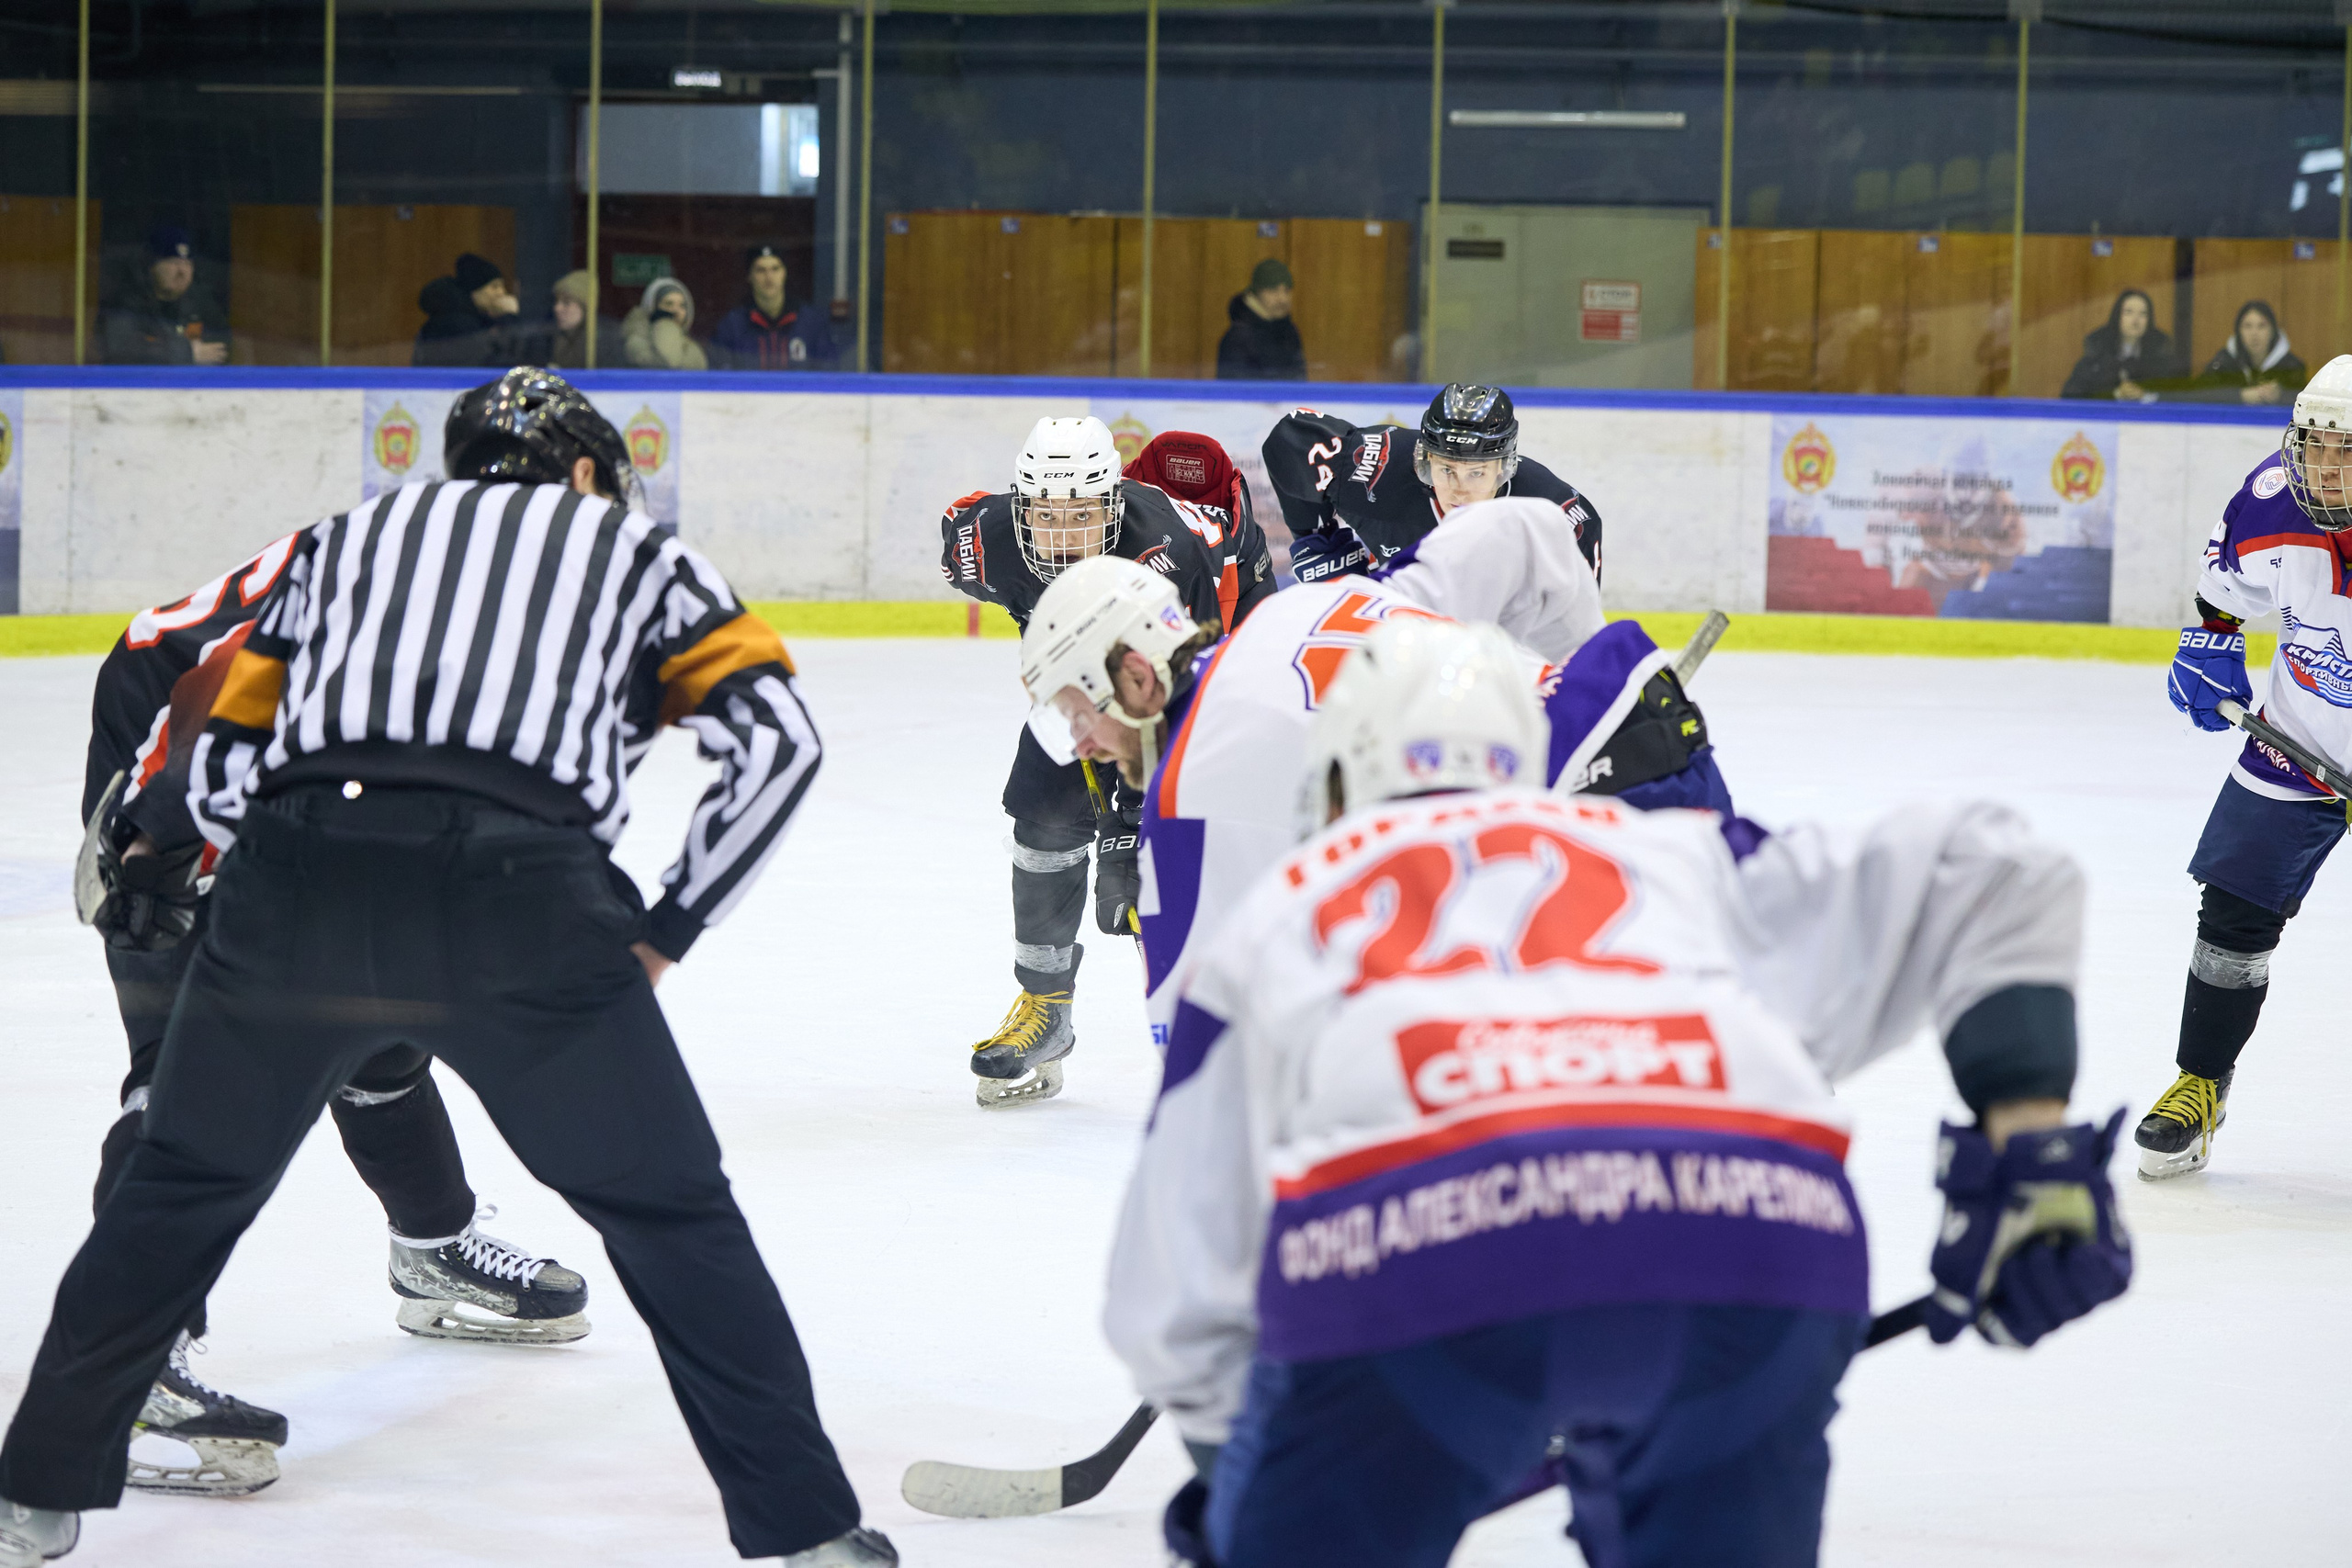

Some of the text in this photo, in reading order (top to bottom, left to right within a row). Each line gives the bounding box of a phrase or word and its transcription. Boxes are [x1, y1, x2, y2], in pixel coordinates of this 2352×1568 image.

[1446, 435, 1478, 445] CCM
[1170, 457, 1201, 466] BAUER
[1303, 547, 1367, 582] BAUER
[2178, 631, 2245, 652] BAUE
[2288, 656, 2352, 691] СПОРТИВНЫ
[1310, 822, 1665, 998] 22
[1413, 1039, 1714, 1104] СПОРТ
[1378, 1150, 1672, 1256] АЛЕКСАНДРА
